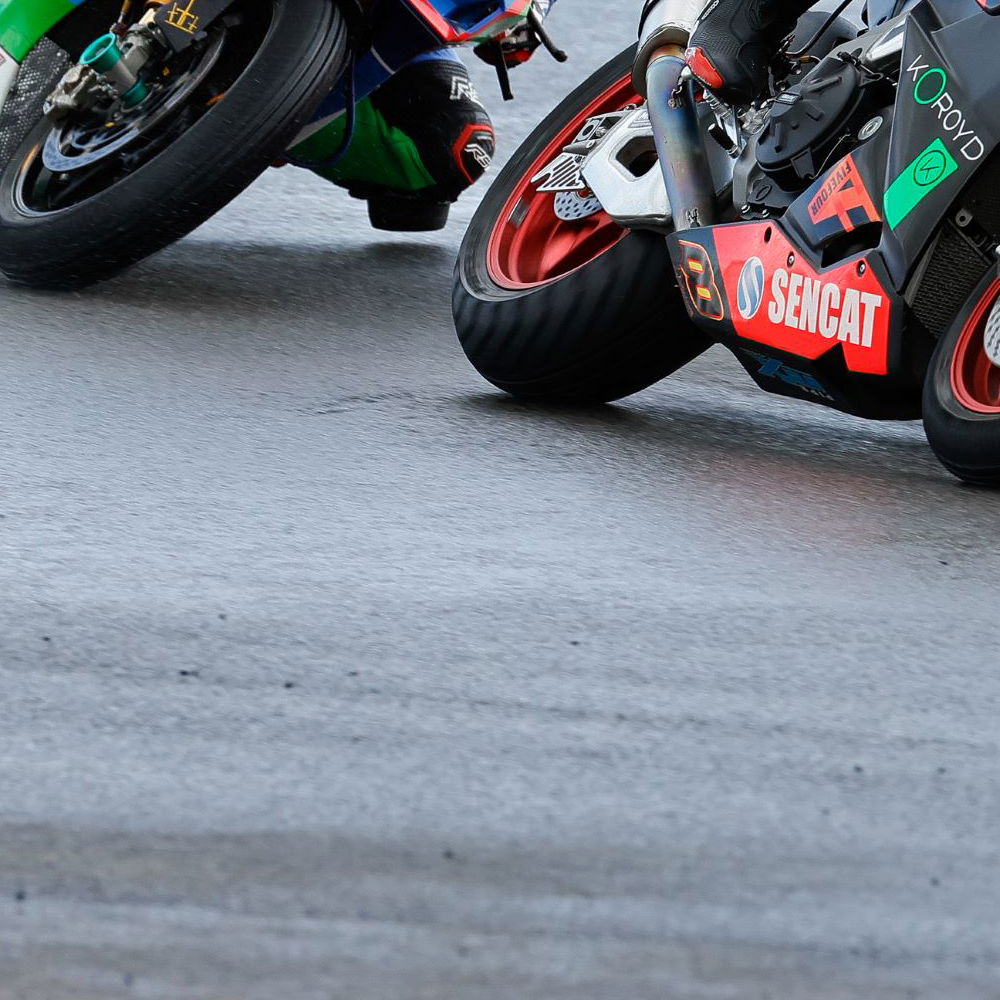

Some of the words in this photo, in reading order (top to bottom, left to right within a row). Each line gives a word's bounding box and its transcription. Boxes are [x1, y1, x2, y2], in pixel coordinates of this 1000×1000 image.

[906, 54, 985, 161] KOROYD
[811, 160, 852, 216] FIVEFOUR
[768, 267, 883, 349] SENCAT
